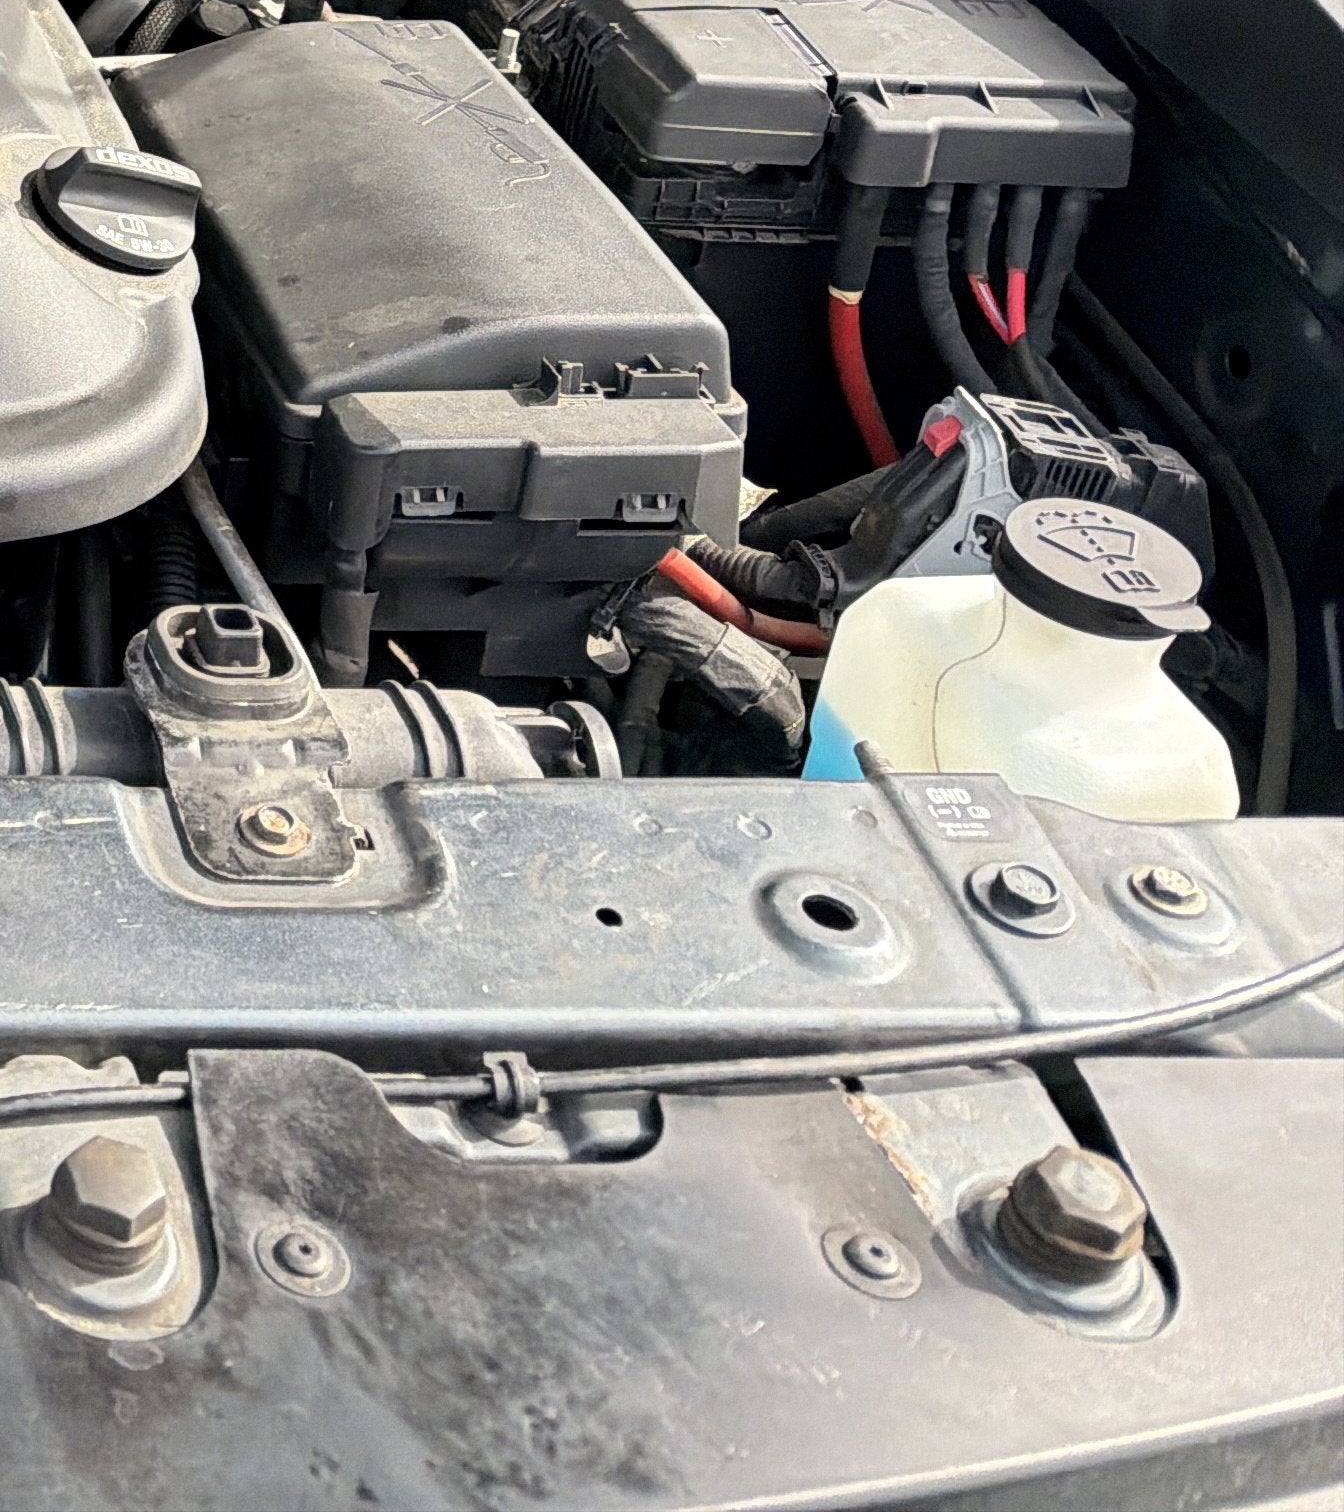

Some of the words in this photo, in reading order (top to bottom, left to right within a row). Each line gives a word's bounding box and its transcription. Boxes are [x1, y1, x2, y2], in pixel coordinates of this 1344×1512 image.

[95, 146, 191, 181] dexos
[95, 224, 125, 247] SAE
[925, 787, 972, 805] GND
